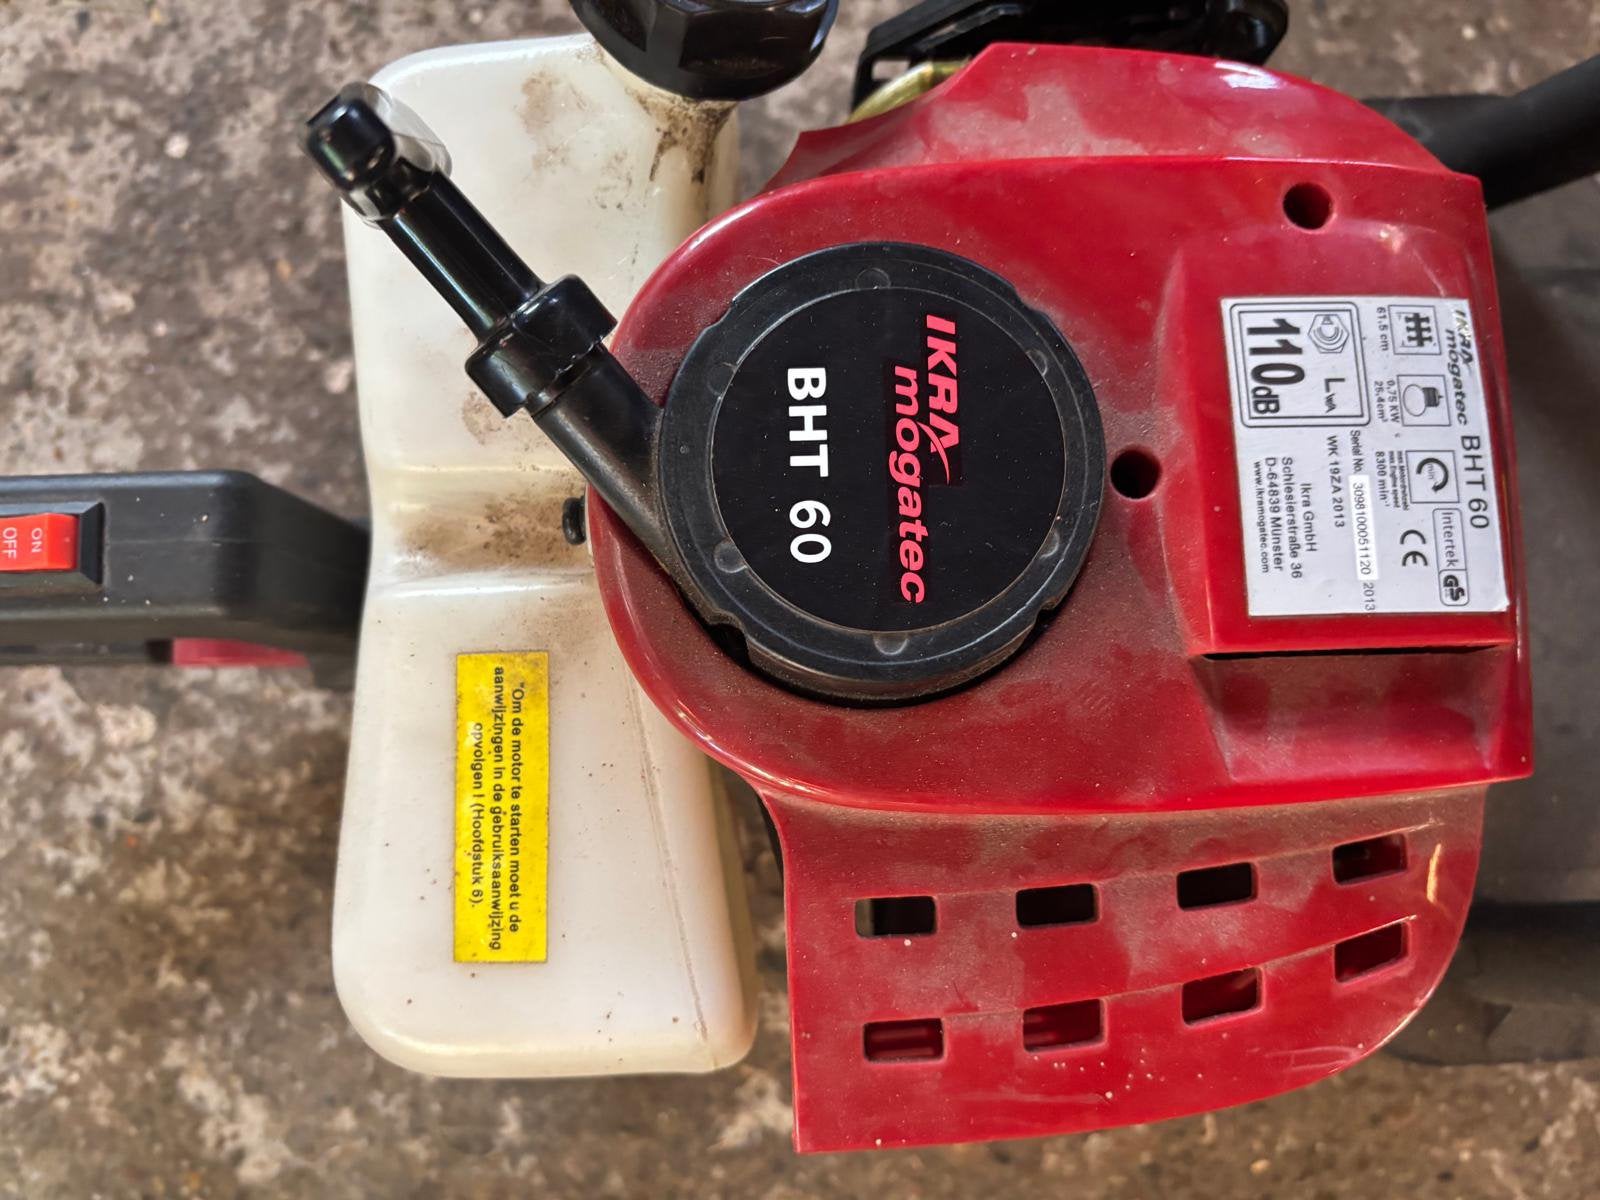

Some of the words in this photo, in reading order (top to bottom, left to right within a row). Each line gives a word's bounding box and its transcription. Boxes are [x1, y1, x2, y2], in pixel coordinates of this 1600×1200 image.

[1380, 334, 1389, 351] cm
[926, 314, 959, 454] IKRA
[1445, 329, 1468, 426] mogatec
[787, 367, 829, 477] BHT
[1327, 435, 1338, 456] WK
[1350, 430, 1362, 455] Serial
[1329, 461, 1341, 494] 19ZA
[1353, 458, 1364, 474] No.
[1375, 451, 1387, 476] 8300
[1461, 435, 1486, 491] BHT
[888, 366, 929, 603] mogatec
[1265, 457, 1279, 513] D-64839
[1300, 483, 1312, 507] Ikra
[1254, 461, 1270, 573] www.ikramogatec.com
[1282, 457, 1300, 558] Schlesierstraße
[1333, 498, 1344, 528] 2013
[1468, 498, 1490, 529] 60
[3, 527, 17, 559] OFF
[31, 528, 43, 552] ON
[789, 500, 832, 563] 60
[1270, 517, 1283, 571] Münster
[1303, 511, 1317, 552] GmbH
[1353, 482, 1371, 575] 3098100051120
[1442, 512, 1459, 567] Intertek
[1290, 562, 1302, 578] 36
[1363, 582, 1375, 611] 2013
[1443, 575, 1465, 601] GS
[491, 667, 506, 763] aanwijzingen
[512, 718, 523, 736] de
[471, 723, 485, 789] opvolgen
[494, 767, 505, 779] in
[511, 740, 522, 782] motor
[494, 784, 505, 802] de
[511, 786, 522, 799] te
[470, 804, 485, 885] (Hoofdstuk
[510, 805, 522, 855] starten
[489, 807, 504, 950] gebruiksaanwijzing
[510, 860, 521, 898] moet
[510, 902, 519, 910] u
[510, 915, 521, 932] de
